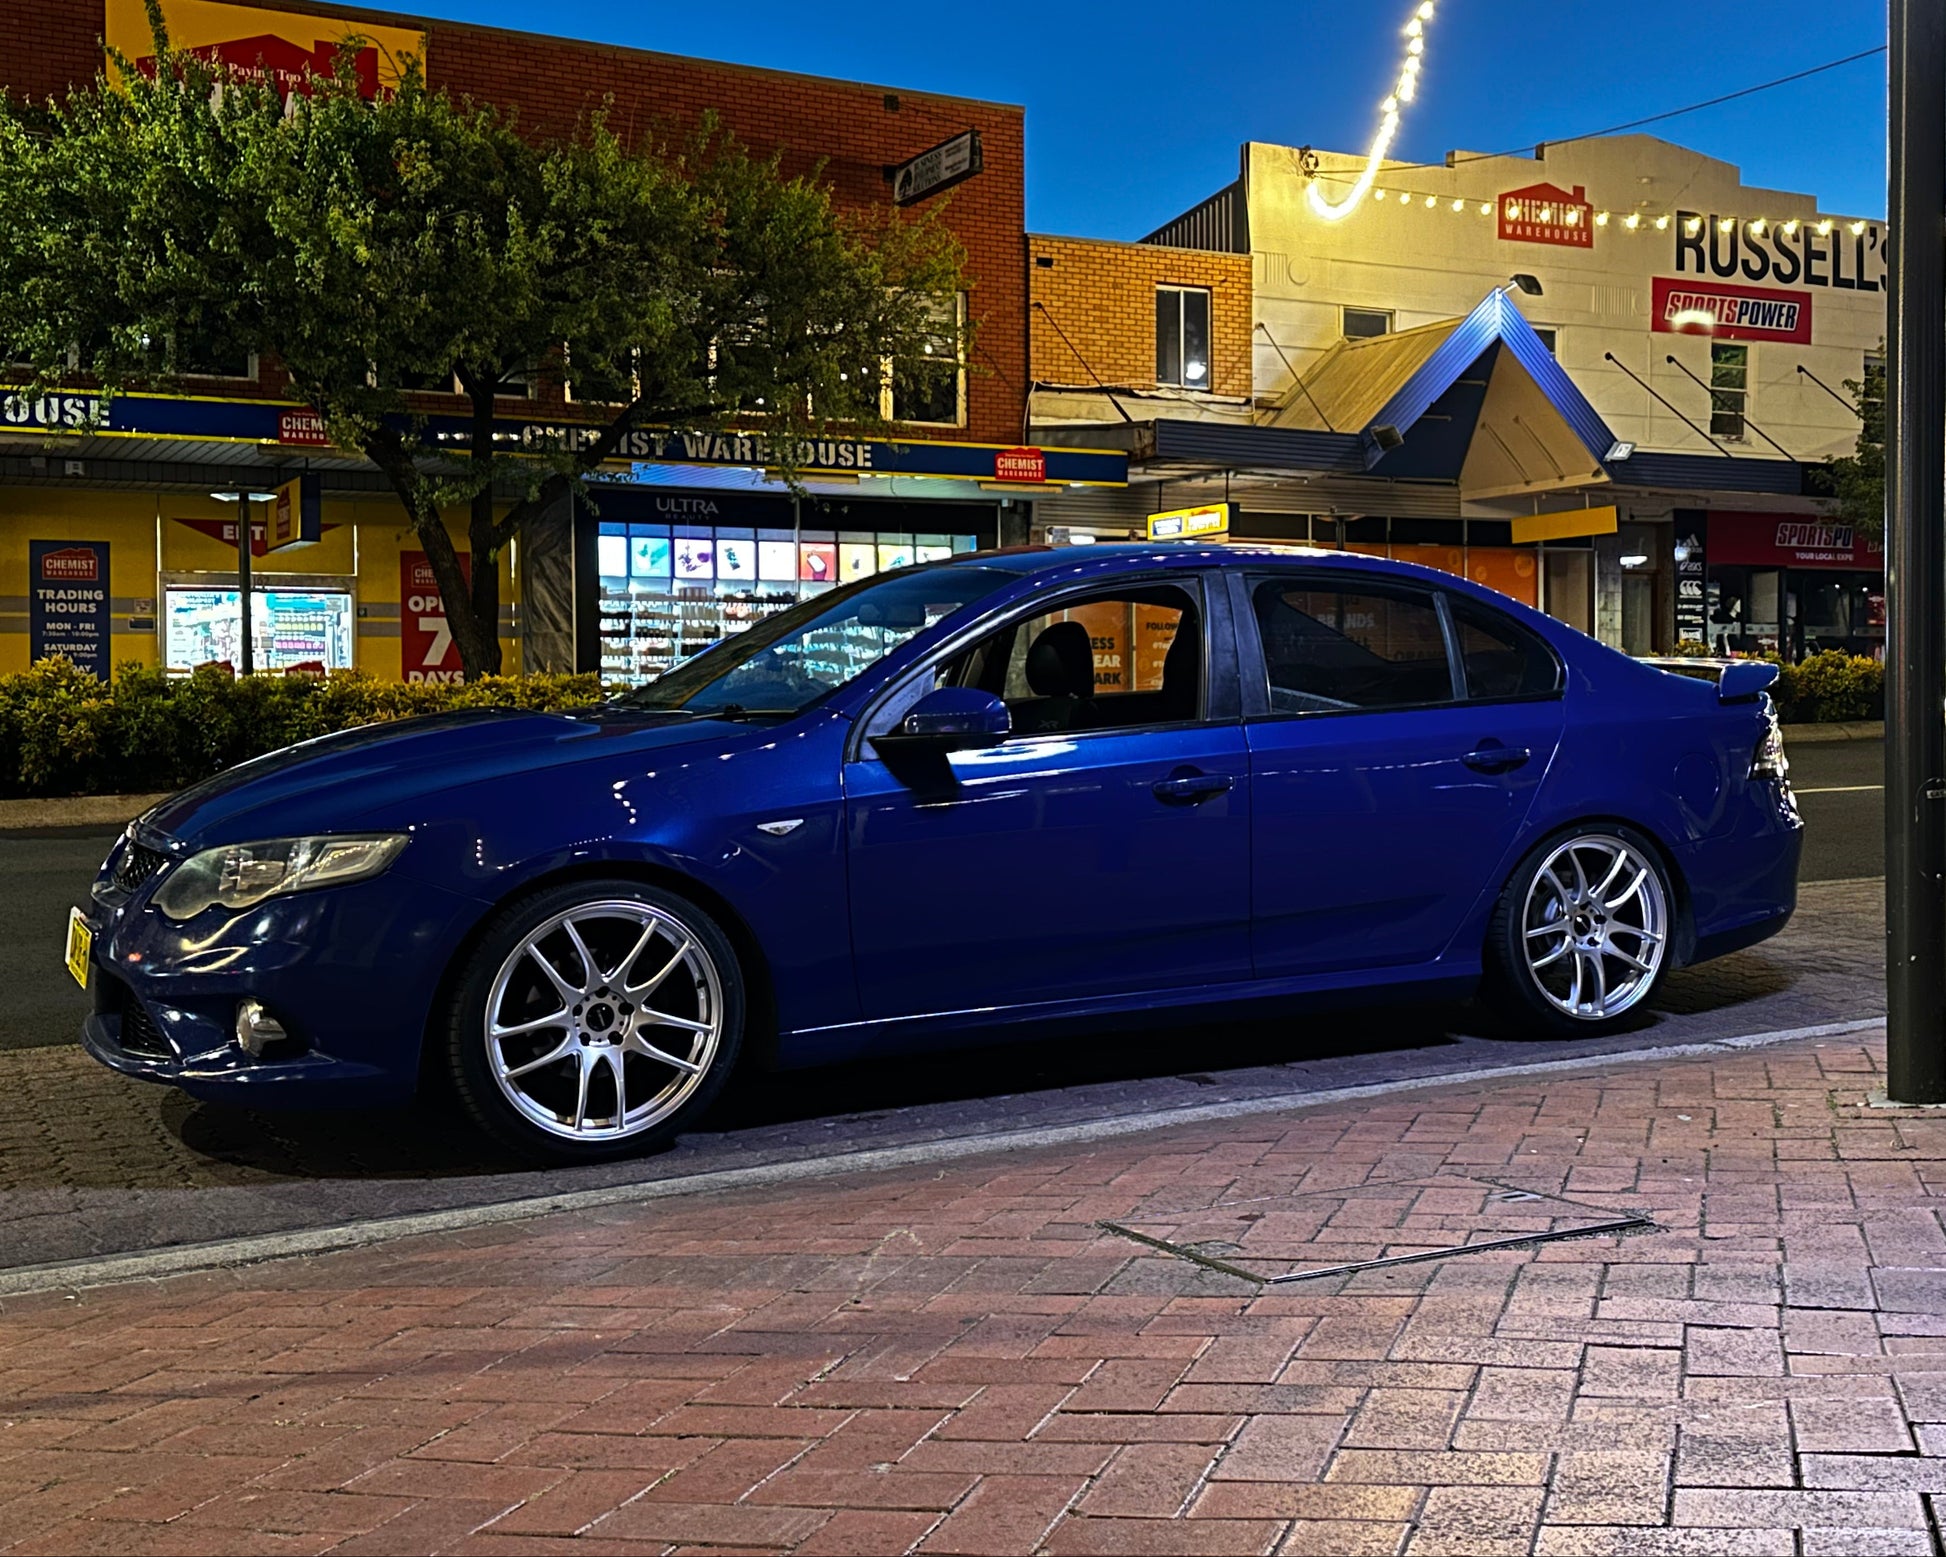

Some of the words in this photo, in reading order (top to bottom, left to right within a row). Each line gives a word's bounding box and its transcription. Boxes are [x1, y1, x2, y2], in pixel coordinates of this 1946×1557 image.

[228, 62, 274, 82] Payin
[276, 69, 300, 83] Too
[1505, 223, 1588, 242] WAREHOUSE
[1676, 210, 1887, 292] RUSSELL'
[282, 416, 324, 432] CHEM
[282, 431, 325, 440] WAREHO
[522, 425, 669, 457] CHEIST
[683, 434, 873, 467] WAREOUSE
[997, 457, 1044, 471] CHEMIST
[656, 497, 720, 515] ULTRA
[45, 559, 95, 570] CHEMIST
[37, 589, 104, 600] TRADING
[45, 603, 97, 613] HOURS
[46, 622, 71, 630] MON
[79, 622, 95, 630] FRI
[1317, 613, 1376, 628] BRNDS
[418, 616, 453, 666] 7
[1091, 637, 1115, 650] ESS
[1093, 654, 1121, 668] EAR
[408, 670, 465, 688] DAYS
[1094, 672, 1121, 685] ARK
